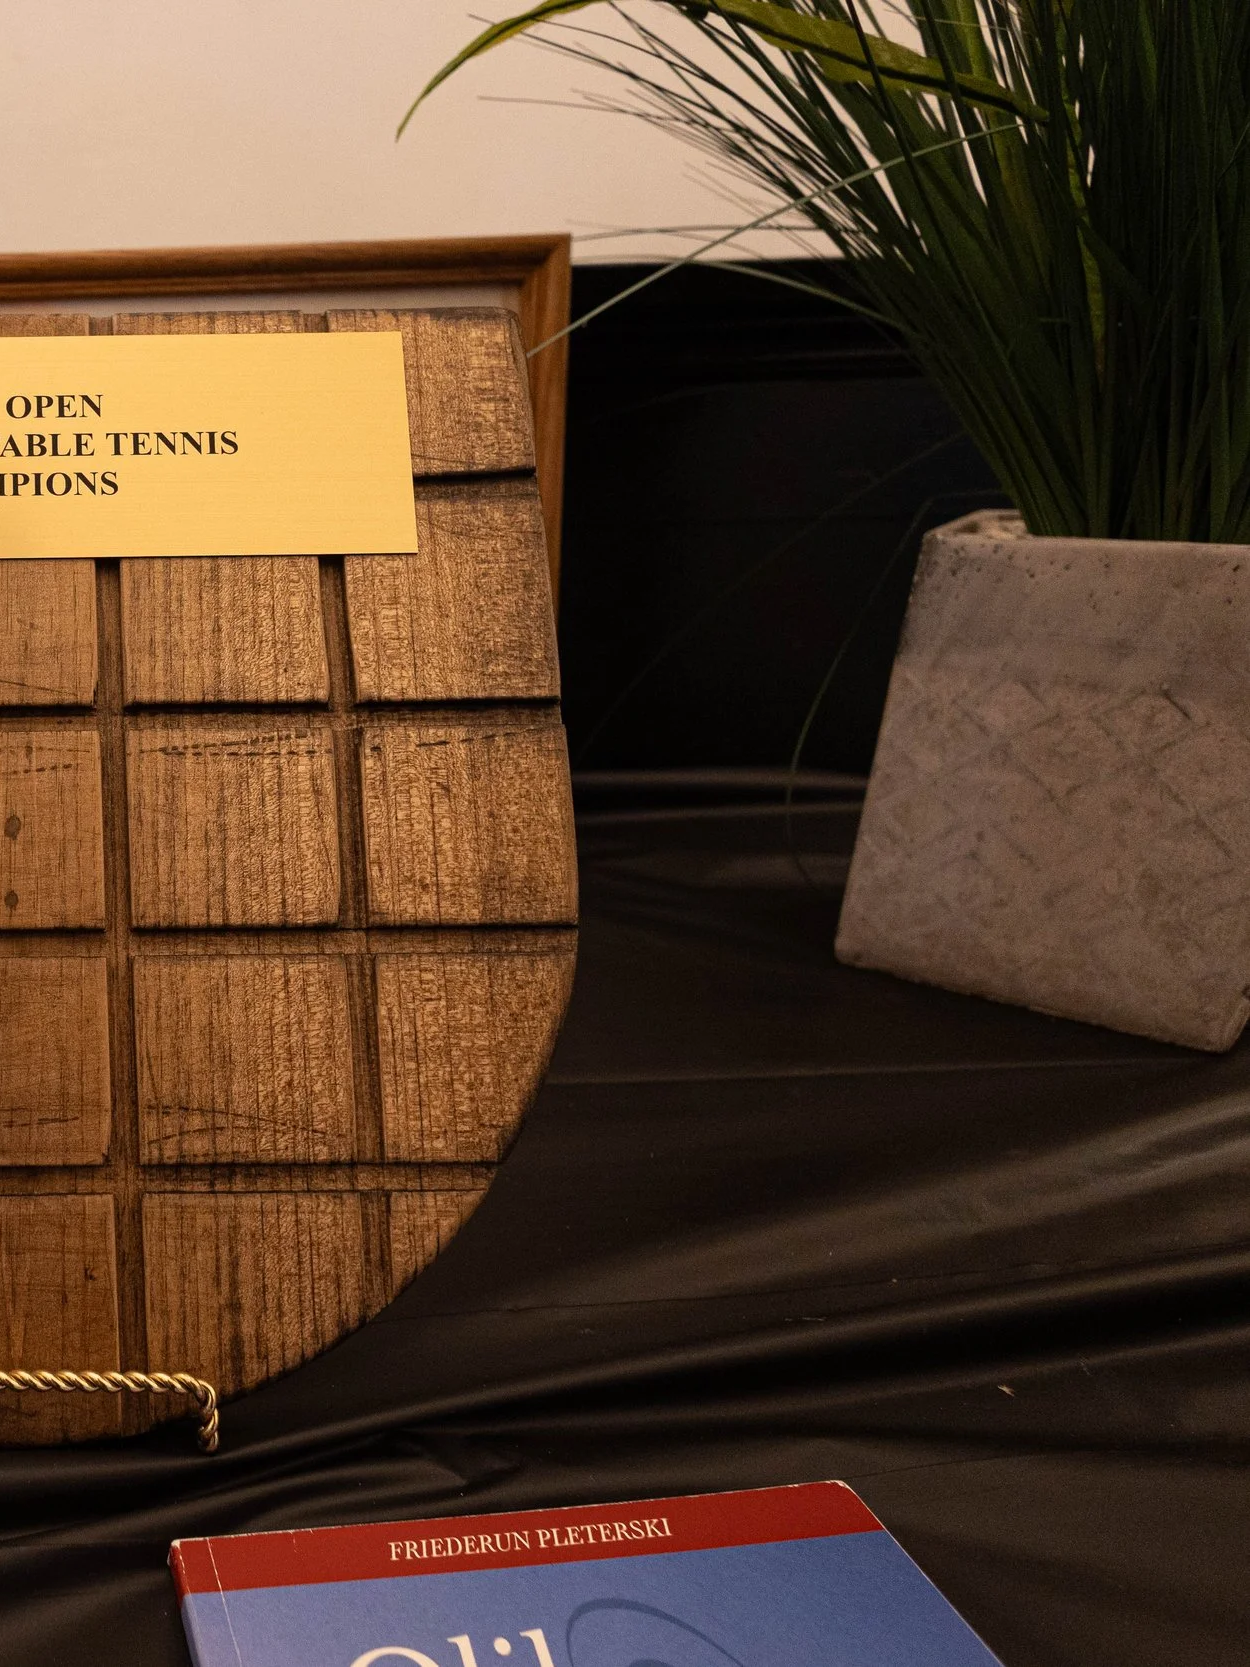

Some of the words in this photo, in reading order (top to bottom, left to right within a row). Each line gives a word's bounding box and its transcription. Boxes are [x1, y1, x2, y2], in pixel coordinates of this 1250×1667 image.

[5, 394, 104, 419] OPEN
[105, 430, 239, 456] TENNIS
[388, 1530, 531, 1561] FRIEDERUN
[535, 1517, 673, 1548] PLETERSKI
